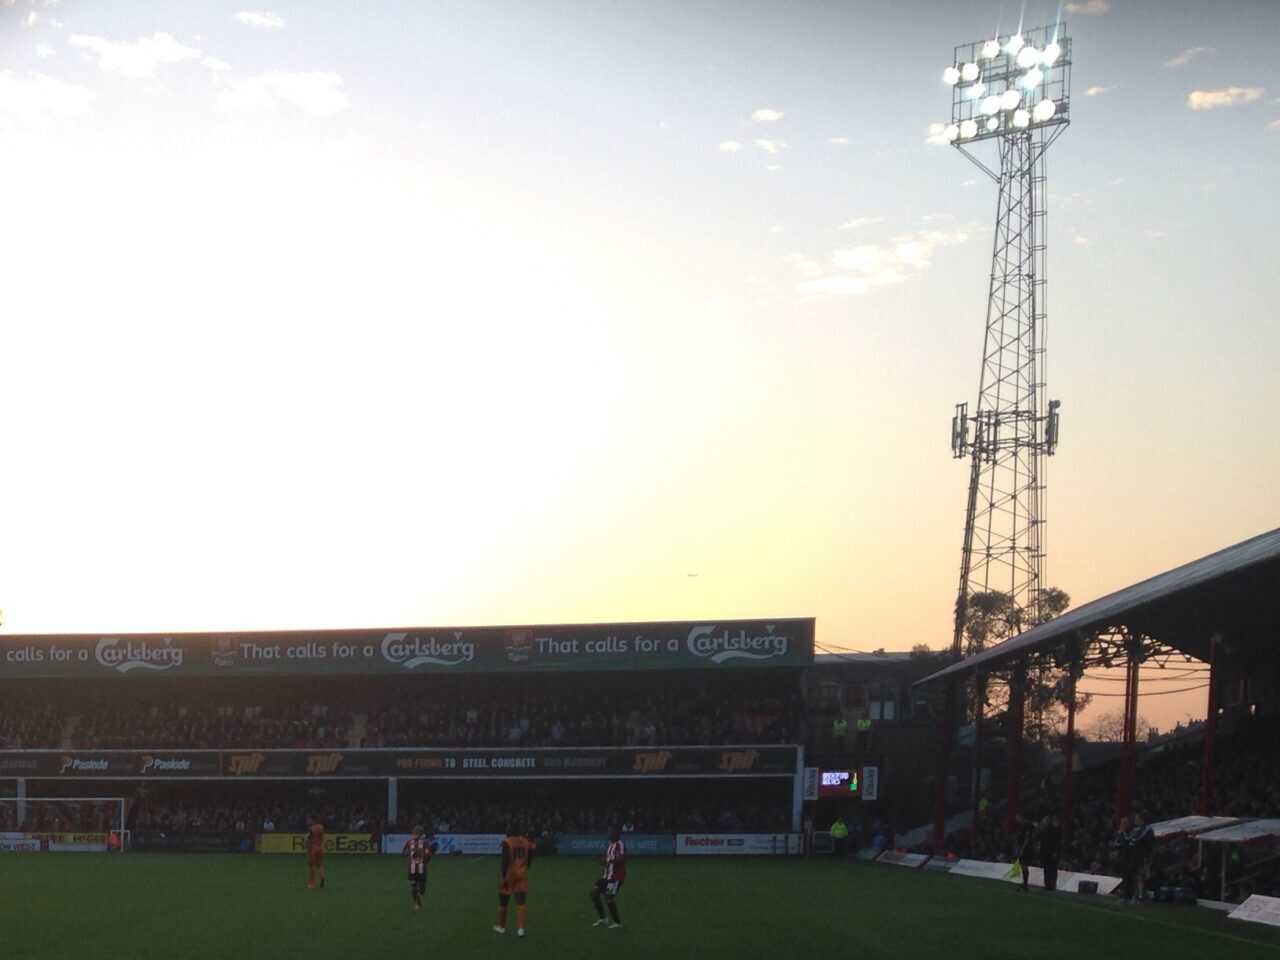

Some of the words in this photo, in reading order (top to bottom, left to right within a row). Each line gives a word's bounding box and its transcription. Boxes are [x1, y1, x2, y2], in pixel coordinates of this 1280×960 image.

[7, 647, 44, 662] calls
[49, 646, 72, 661] for
[78, 651, 88, 661] a
[95, 638, 183, 670] Carlsberg
[240, 643, 280, 659] That
[287, 641, 326, 659] calls
[332, 641, 357, 657] for
[363, 646, 374, 657] a
[381, 633, 474, 666] Carlsberg
[536, 637, 580, 654] That
[585, 635, 627, 653] calls
[634, 634, 661, 651] for
[667, 640, 679, 651] a
[688, 625, 788, 661] Carlsberg
